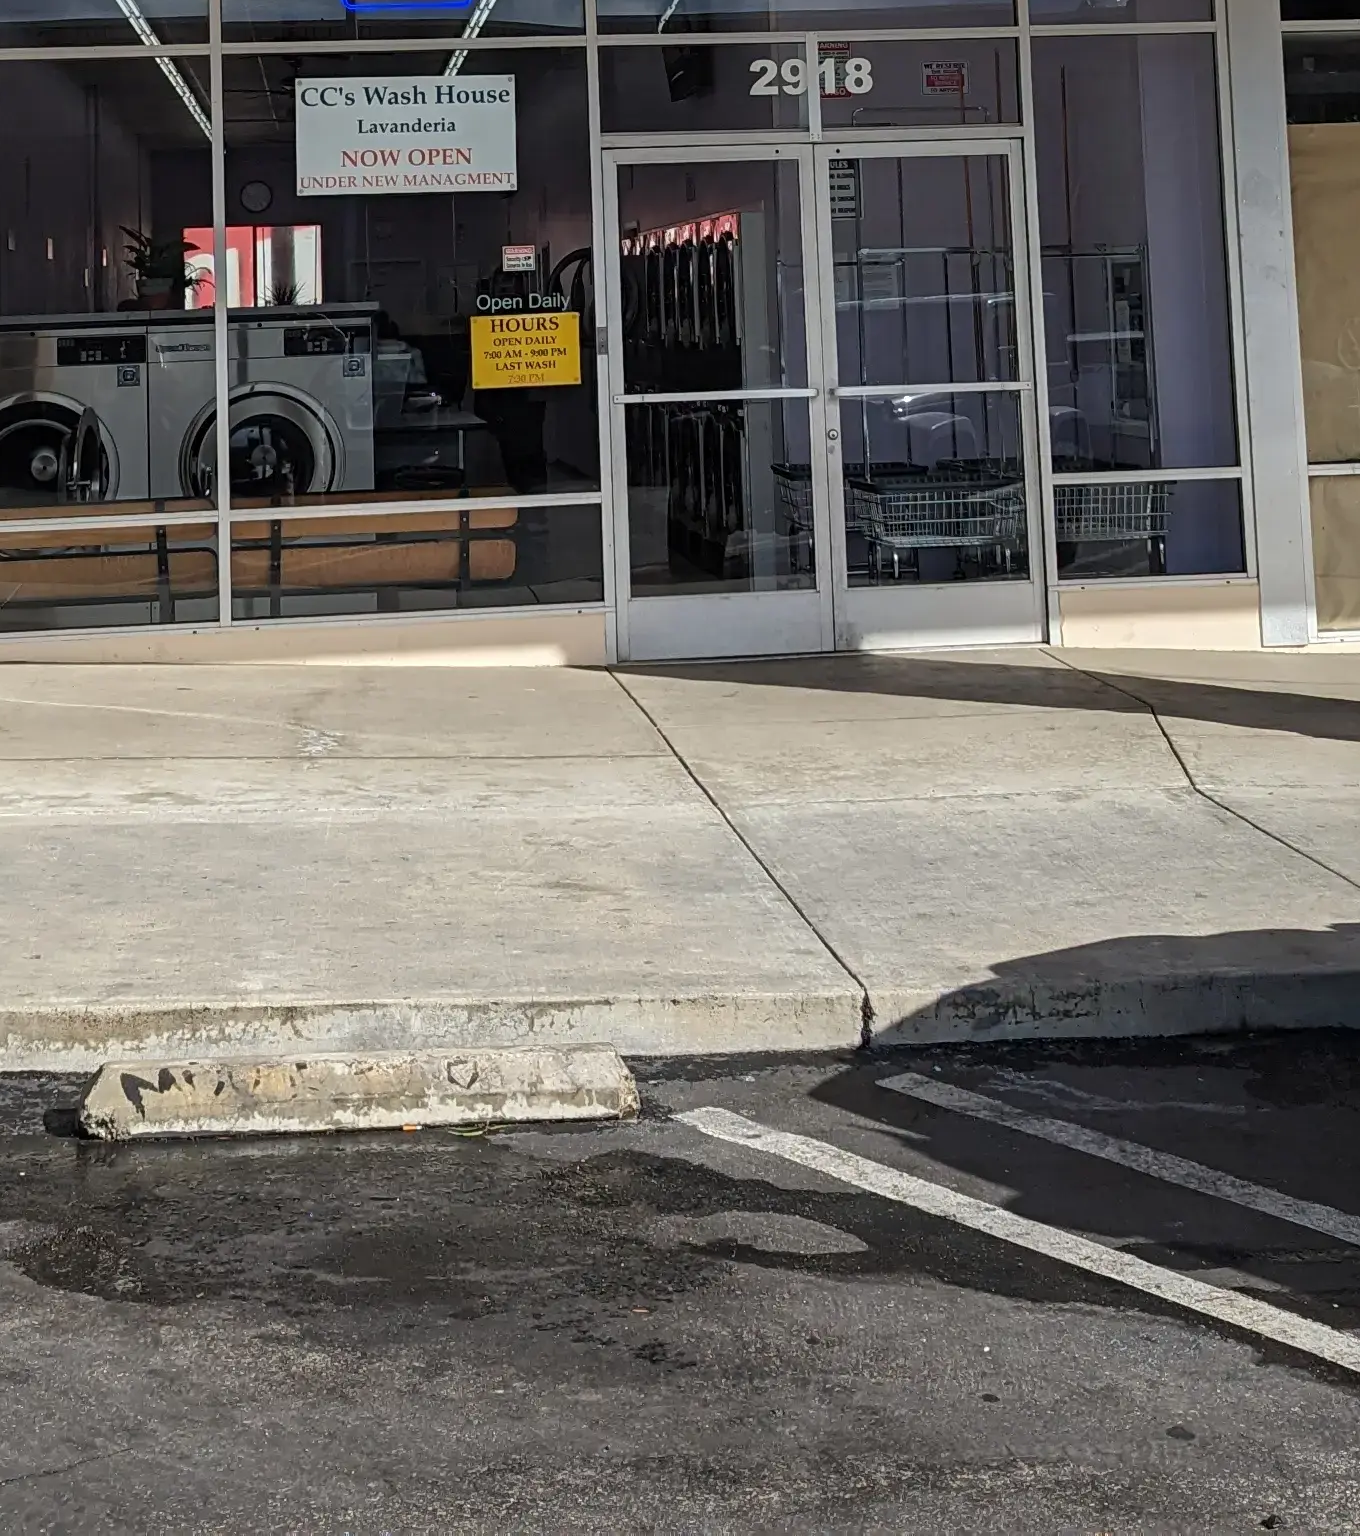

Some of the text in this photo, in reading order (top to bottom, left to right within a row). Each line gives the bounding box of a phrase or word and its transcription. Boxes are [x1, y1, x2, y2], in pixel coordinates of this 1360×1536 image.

[749, 57, 873, 95] 2918
[300, 84, 510, 107] CC's Wash House
[357, 117, 456, 134] Lavanderia
[340, 147, 473, 168] NOW OPEN
[300, 172, 515, 189] UNDER NEW MANAGMENT
[477, 293, 570, 313] Open Daily
[490, 316, 559, 333] HOURS
[493, 336, 557, 346] OPEN DAILY
[484, 351, 502, 360] 7:00
[504, 349, 522, 358] AM
[551, 347, 567, 356] PM
[495, 360, 556, 371] LAST WASH
[528, 373, 545, 383] PM
